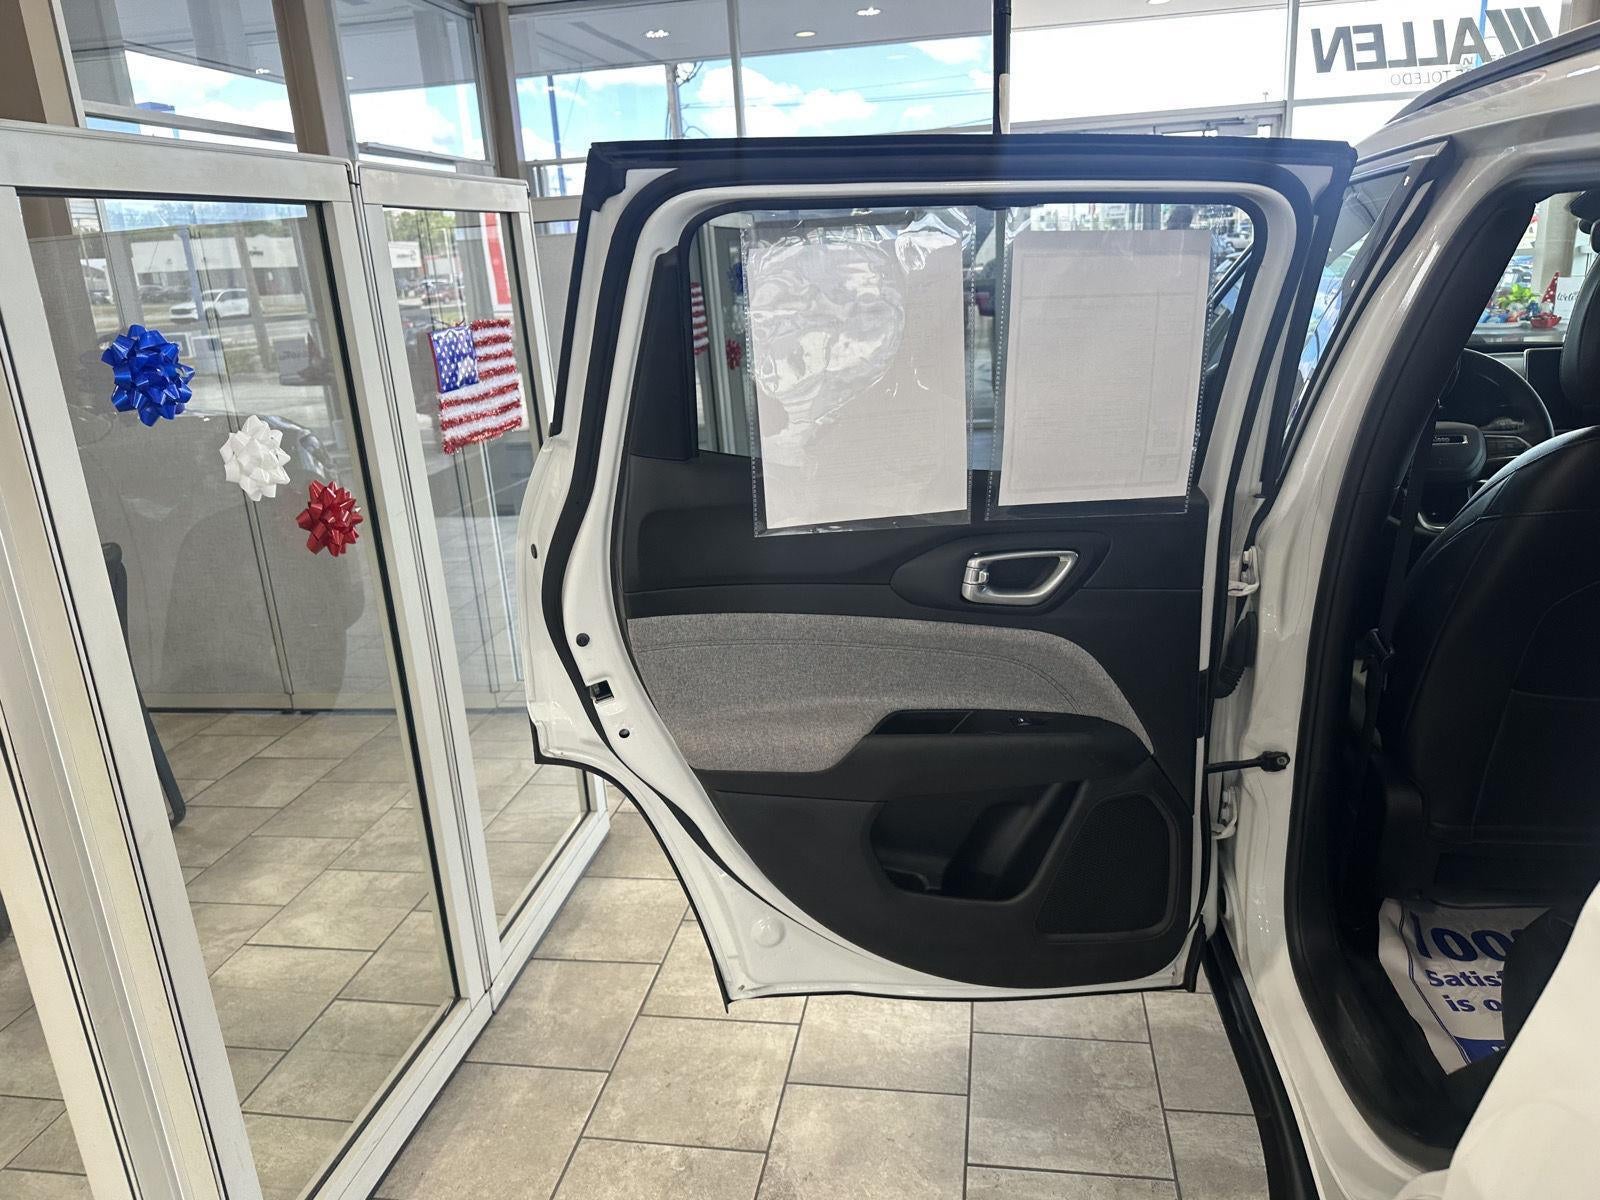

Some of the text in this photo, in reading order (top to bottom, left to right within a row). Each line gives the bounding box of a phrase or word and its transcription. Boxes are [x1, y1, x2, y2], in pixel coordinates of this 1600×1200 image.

[1409, 911, 1524, 962] 100
[1441, 994, 1502, 1012] is o
